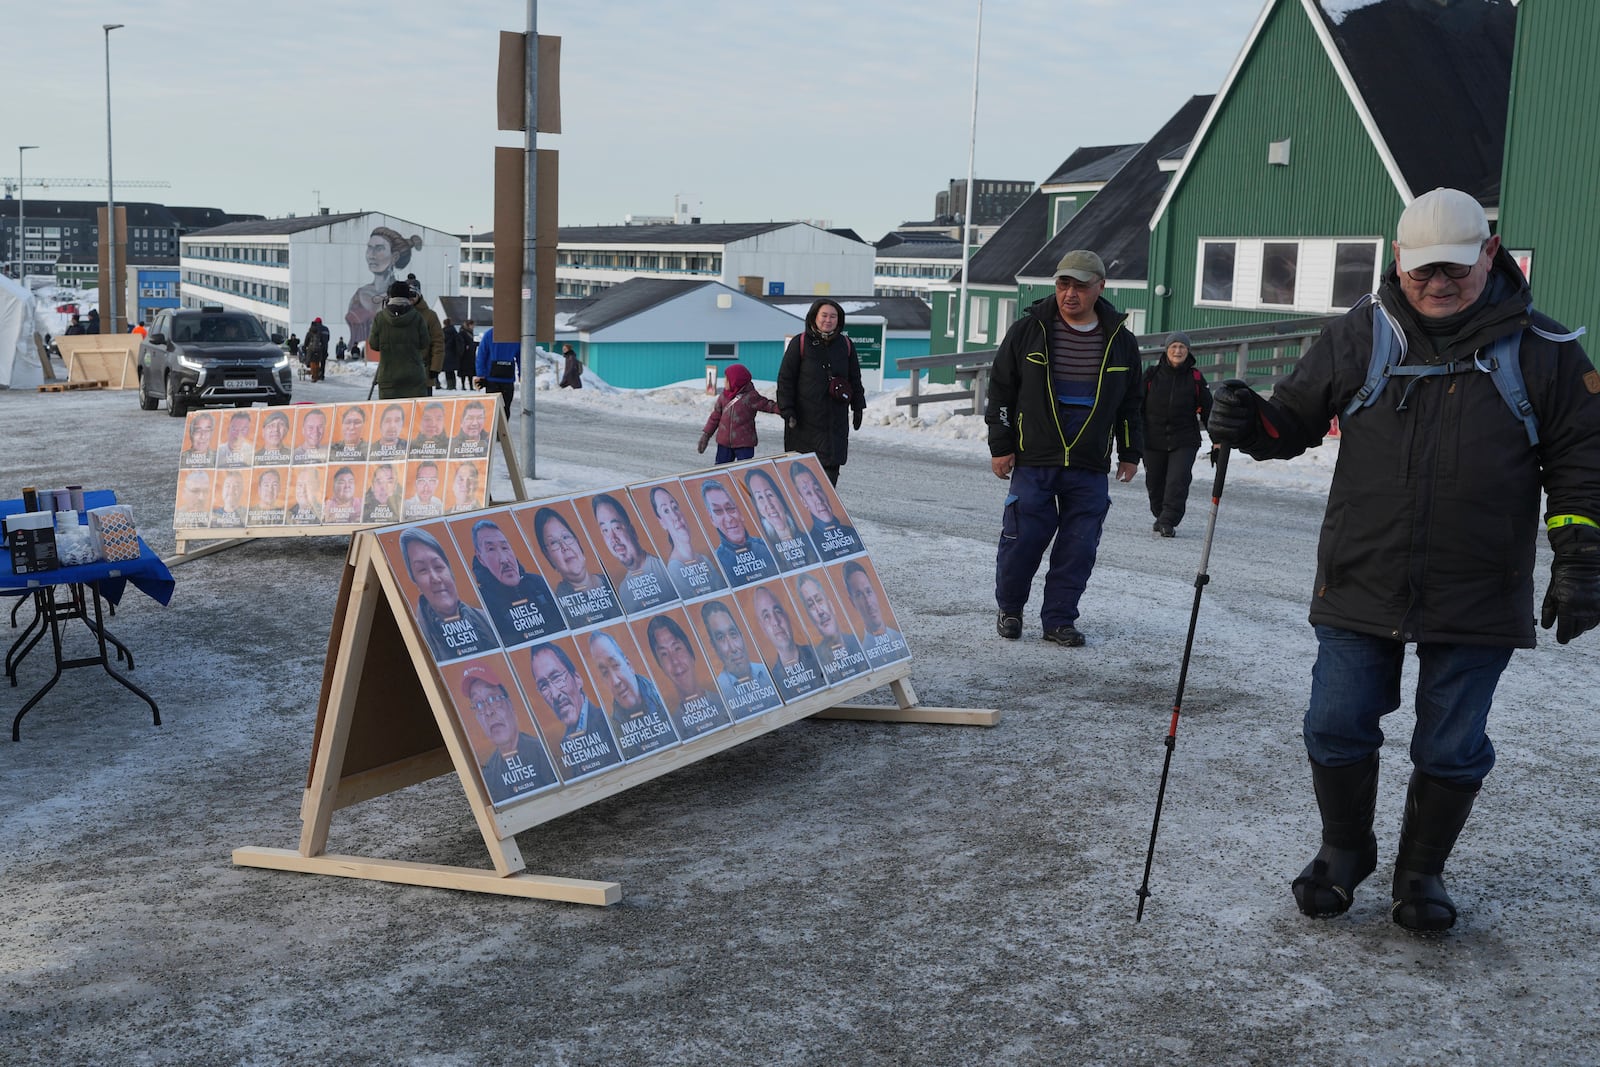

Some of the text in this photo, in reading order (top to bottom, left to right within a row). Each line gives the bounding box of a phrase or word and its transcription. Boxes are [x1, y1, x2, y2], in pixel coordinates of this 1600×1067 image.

[824, 528, 844, 540] SILAS
[821, 535, 855, 552] SIMONSEN
[736, 552, 755, 564] AGGU
[784, 548, 806, 561] OLSEN
[680, 562, 709, 578] DORTHE
[733, 559, 766, 576] BENTZEN
[626, 573, 658, 590] ANDERS
[688, 574, 710, 586] QVIST
[559, 592, 586, 608] METTE
[632, 584, 662, 601] JENSEN
[509, 602, 538, 620] NIELS
[568, 598, 613, 618] HAMMEKEN
[440, 619, 474, 638] JONNA
[514, 613, 545, 632] GRIMM
[446, 630, 478, 648] OLSEN
[832, 647, 849, 660] JENS
[866, 640, 904, 659] BERTHELSEN
[734, 679, 760, 695] VITTUS
[783, 669, 816, 689] CHEMNITZ
[683, 697, 709, 715] JOHAN
[728, 686, 775, 709] QUJAUKITSOQ
[620, 712, 661, 735] NUKA OLE
[682, 705, 719, 727] ROSBACH
[560, 732, 600, 755] KRISTIAN
[619, 720, 671, 749] BERTHELSEN
[506, 755, 523, 770] ELI
[561, 742, 610, 768] KLEEMANN
[501, 765, 537, 786] KUITSE
